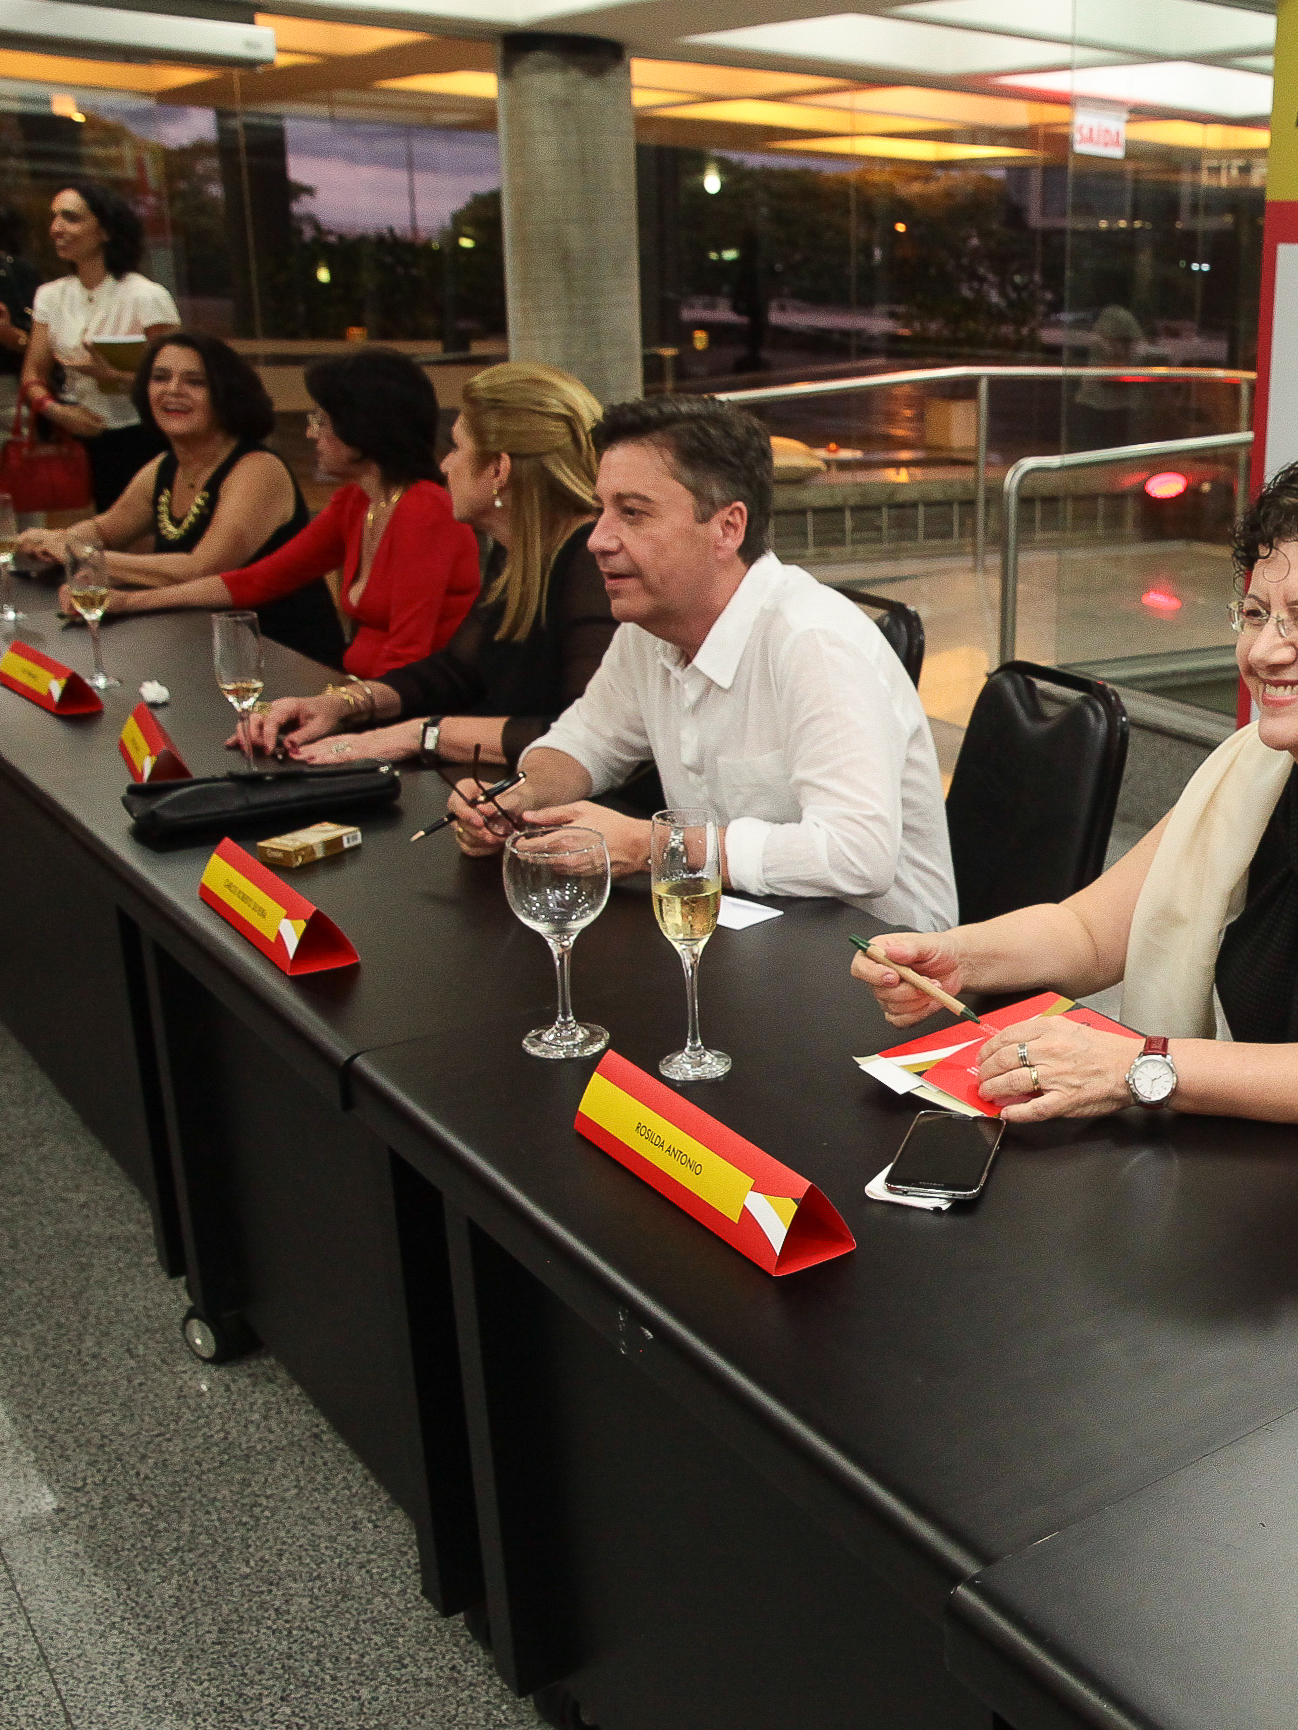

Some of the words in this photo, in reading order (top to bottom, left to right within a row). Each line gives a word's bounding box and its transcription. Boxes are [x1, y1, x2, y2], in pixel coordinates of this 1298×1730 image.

[1077, 122, 1122, 148] SAÍDA
[635, 1121, 665, 1151] ROSILDA
[665, 1144, 703, 1176] ANTONIO
